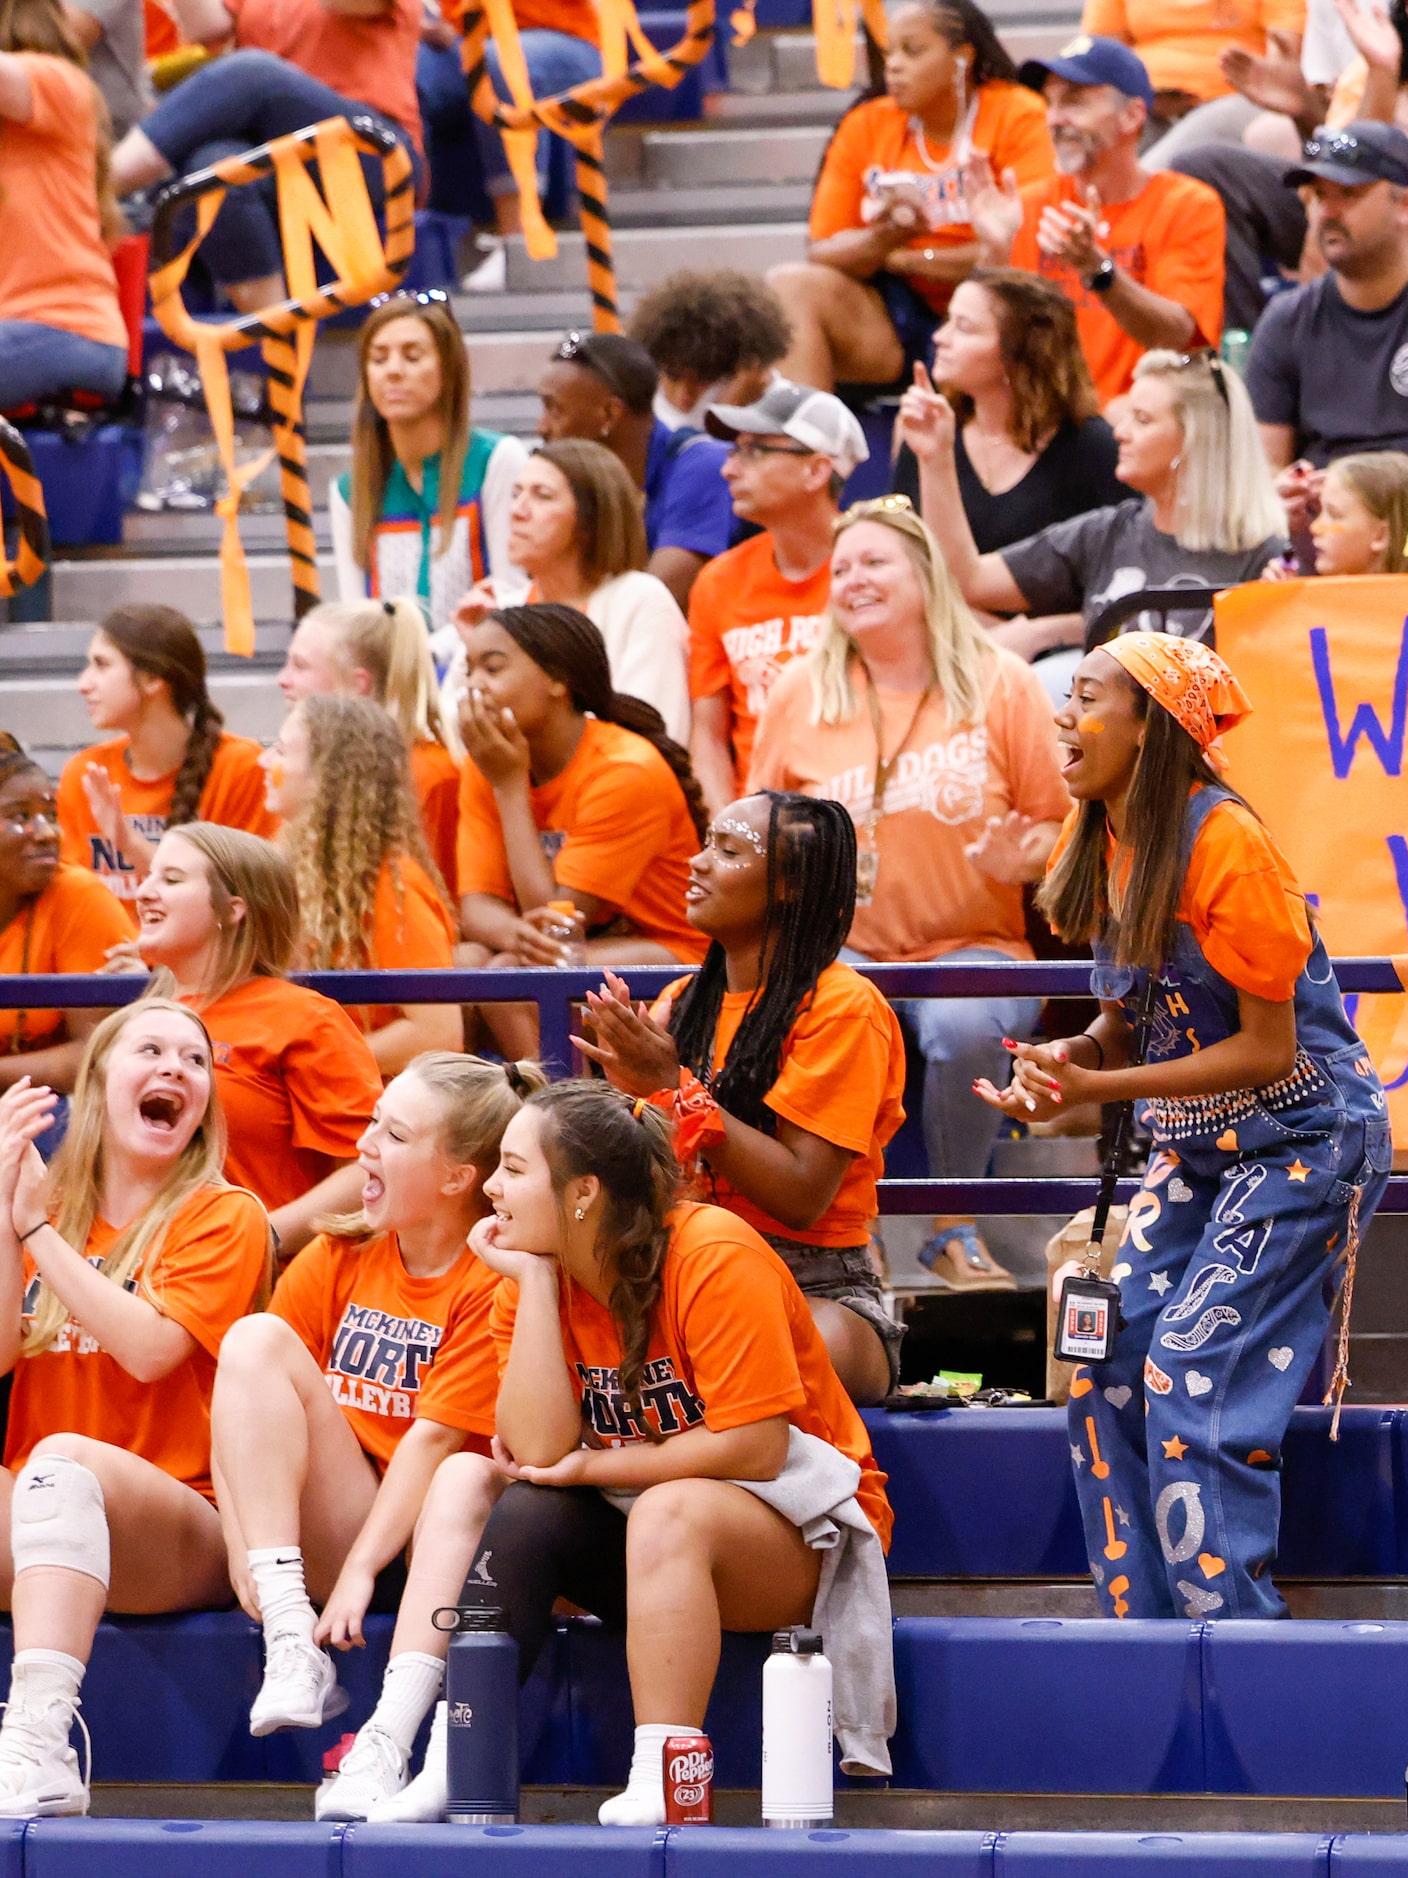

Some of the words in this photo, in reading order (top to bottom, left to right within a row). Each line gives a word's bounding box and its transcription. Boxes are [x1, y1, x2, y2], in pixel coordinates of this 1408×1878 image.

[688, 1751, 707, 1768] Dr
[669, 1755, 714, 1785] Pepper
[682, 1789, 696, 1801] 23
